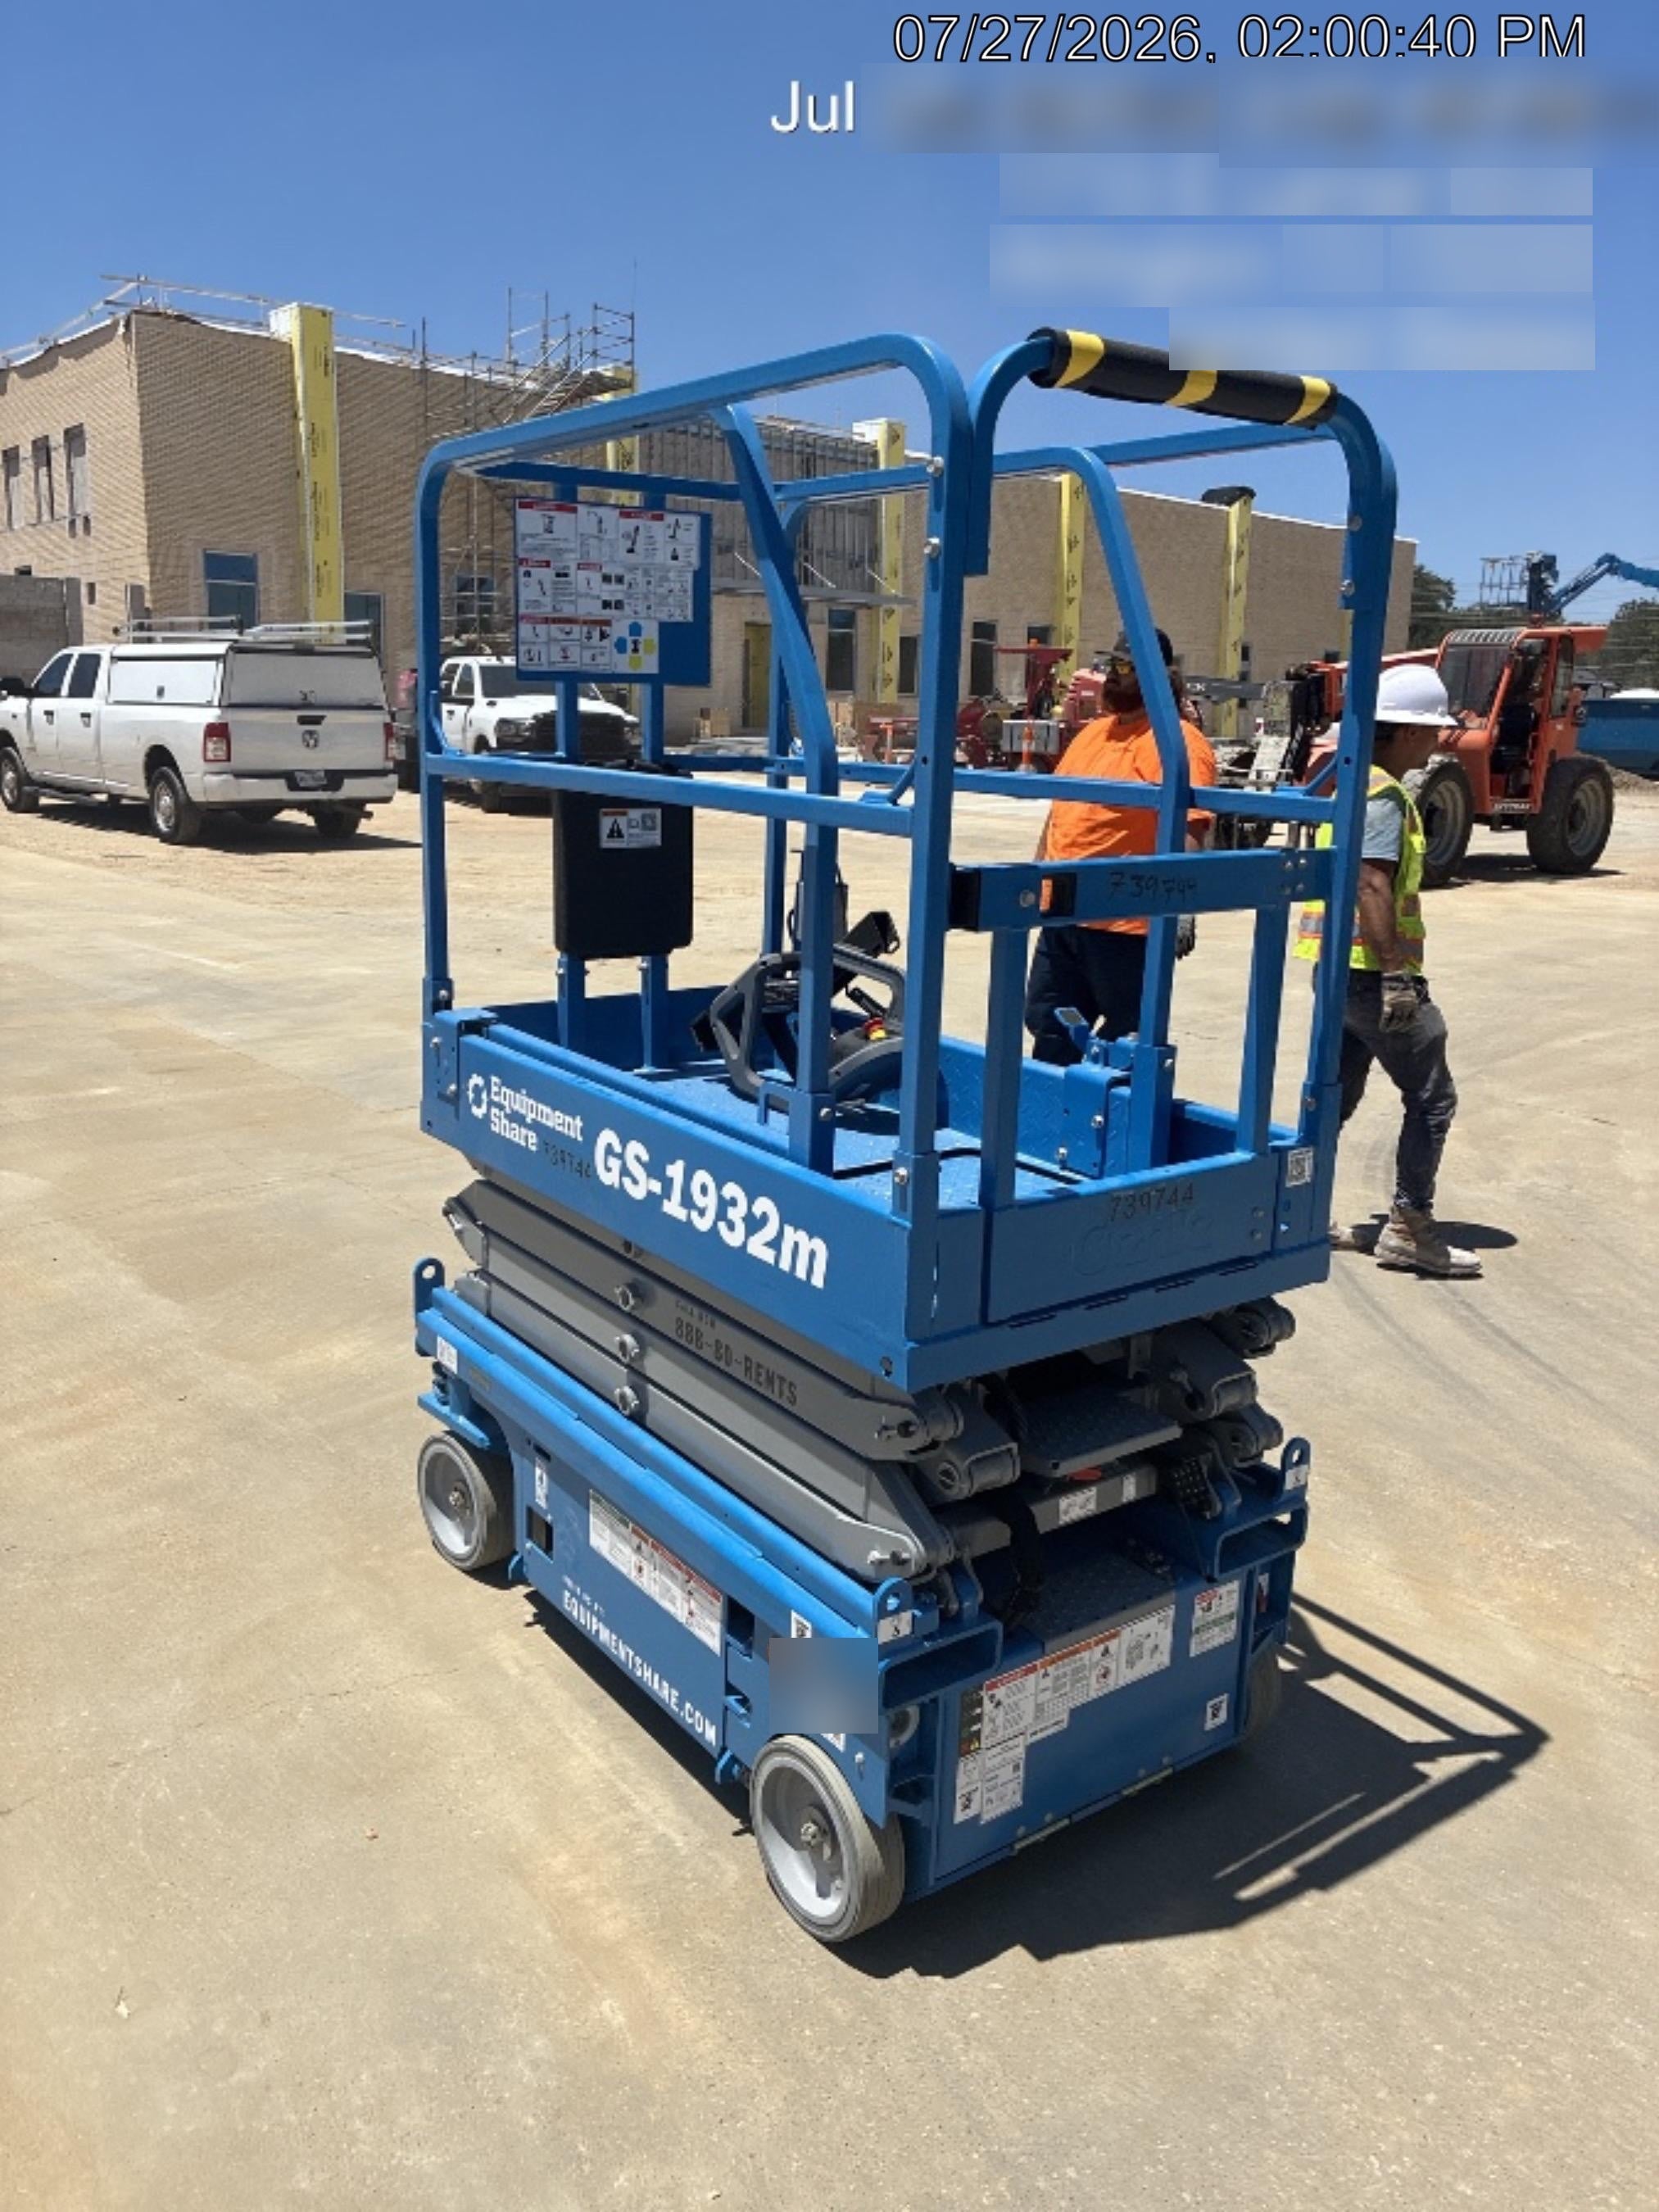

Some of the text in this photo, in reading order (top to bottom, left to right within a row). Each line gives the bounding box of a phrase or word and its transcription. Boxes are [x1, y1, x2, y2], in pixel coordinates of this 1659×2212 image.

[490, 1076, 583, 1141] Equipment
[491, 1108, 537, 1151] Share
[594, 1128, 828, 1290] GS-1932m
[1110, 1182, 1194, 1222] 739744
[563, 1589, 716, 1746] EQUIPMENTSHARE.COM
